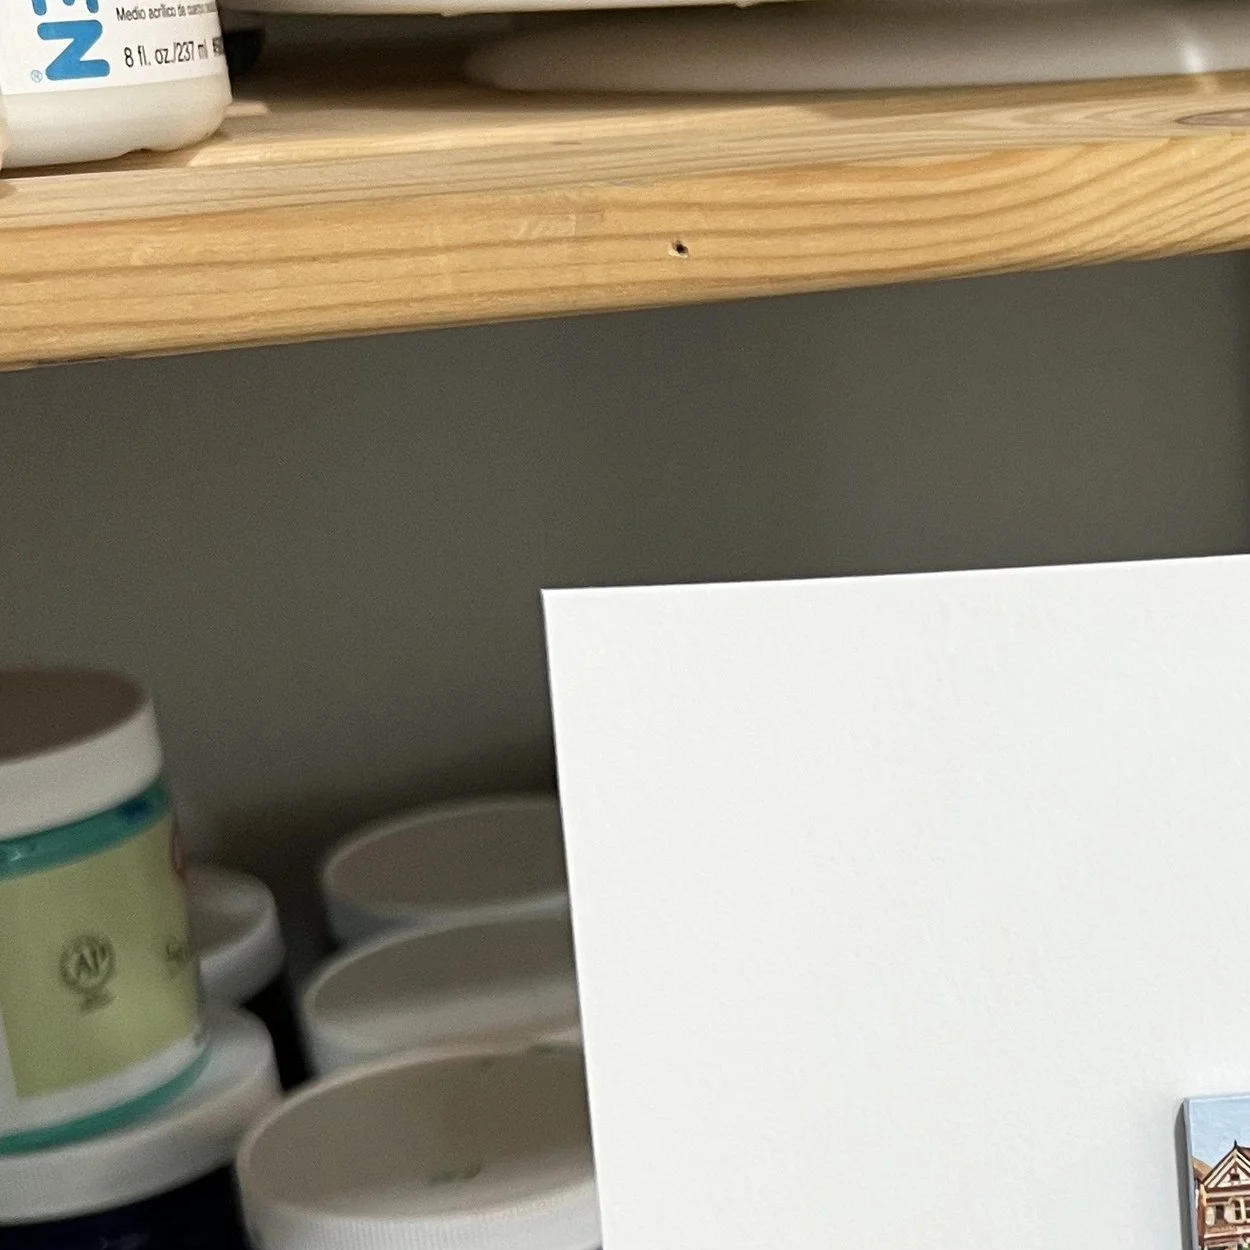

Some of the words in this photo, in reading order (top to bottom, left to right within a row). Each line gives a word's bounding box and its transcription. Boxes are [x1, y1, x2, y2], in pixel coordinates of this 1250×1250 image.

[116, 6, 146, 21] Medio
[123, 46, 134, 67] 8
[137, 45, 151, 66] fl.
